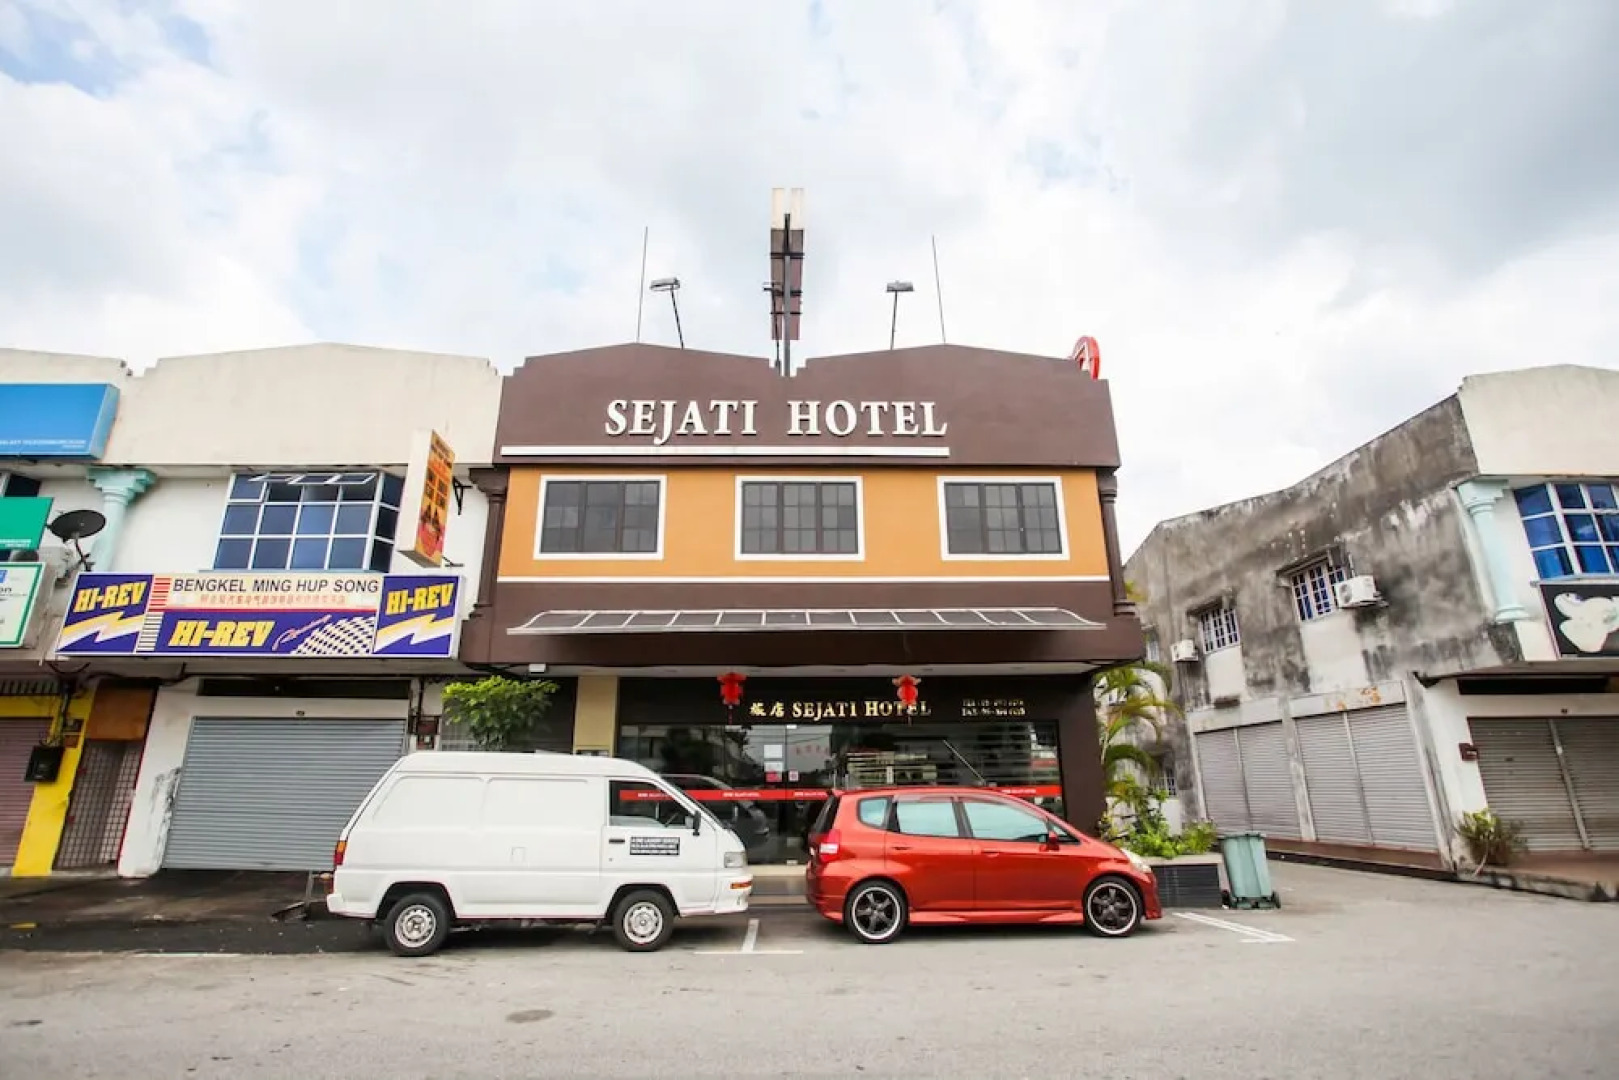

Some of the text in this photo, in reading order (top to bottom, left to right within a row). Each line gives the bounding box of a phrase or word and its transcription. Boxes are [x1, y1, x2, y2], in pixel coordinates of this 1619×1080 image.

[604, 400, 948, 445] SEJATI HOTEL
[73, 581, 148, 613] HI-REV
[173, 579, 379, 593] BENGKEL MING HUP SONG
[385, 582, 454, 615] HI-REV
[168, 620, 275, 647] HI-REV
[792, 701, 857, 721] SEJATI
